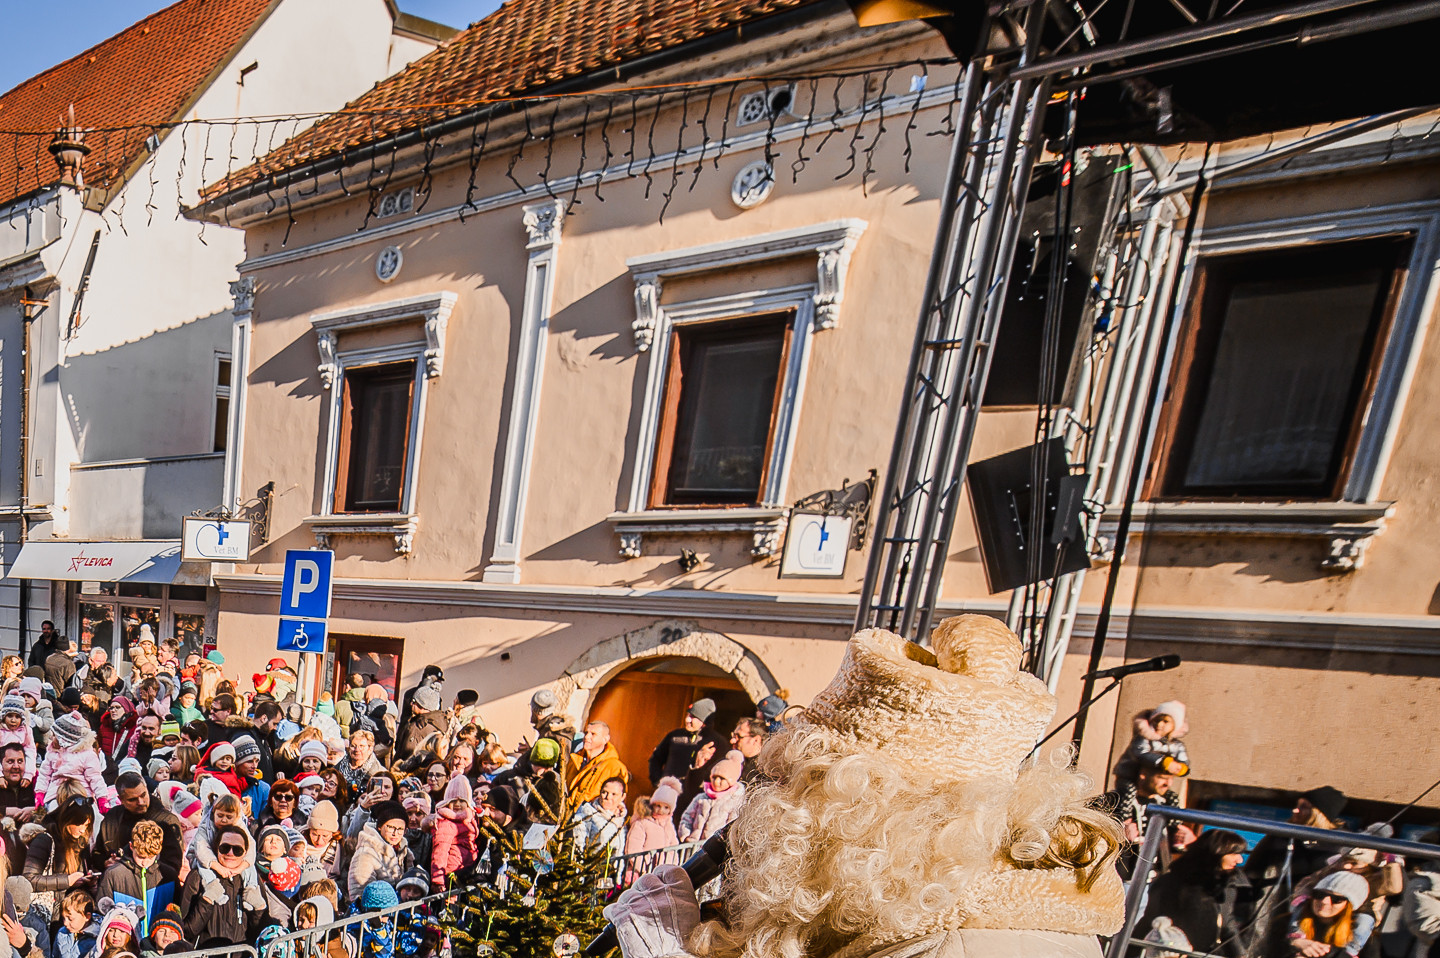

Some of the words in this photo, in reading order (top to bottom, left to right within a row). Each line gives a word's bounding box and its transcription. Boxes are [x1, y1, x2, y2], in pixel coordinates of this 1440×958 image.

[83, 557, 114, 567] LEVICA
[290, 559, 320, 608] P
[660, 626, 683, 644] 20
